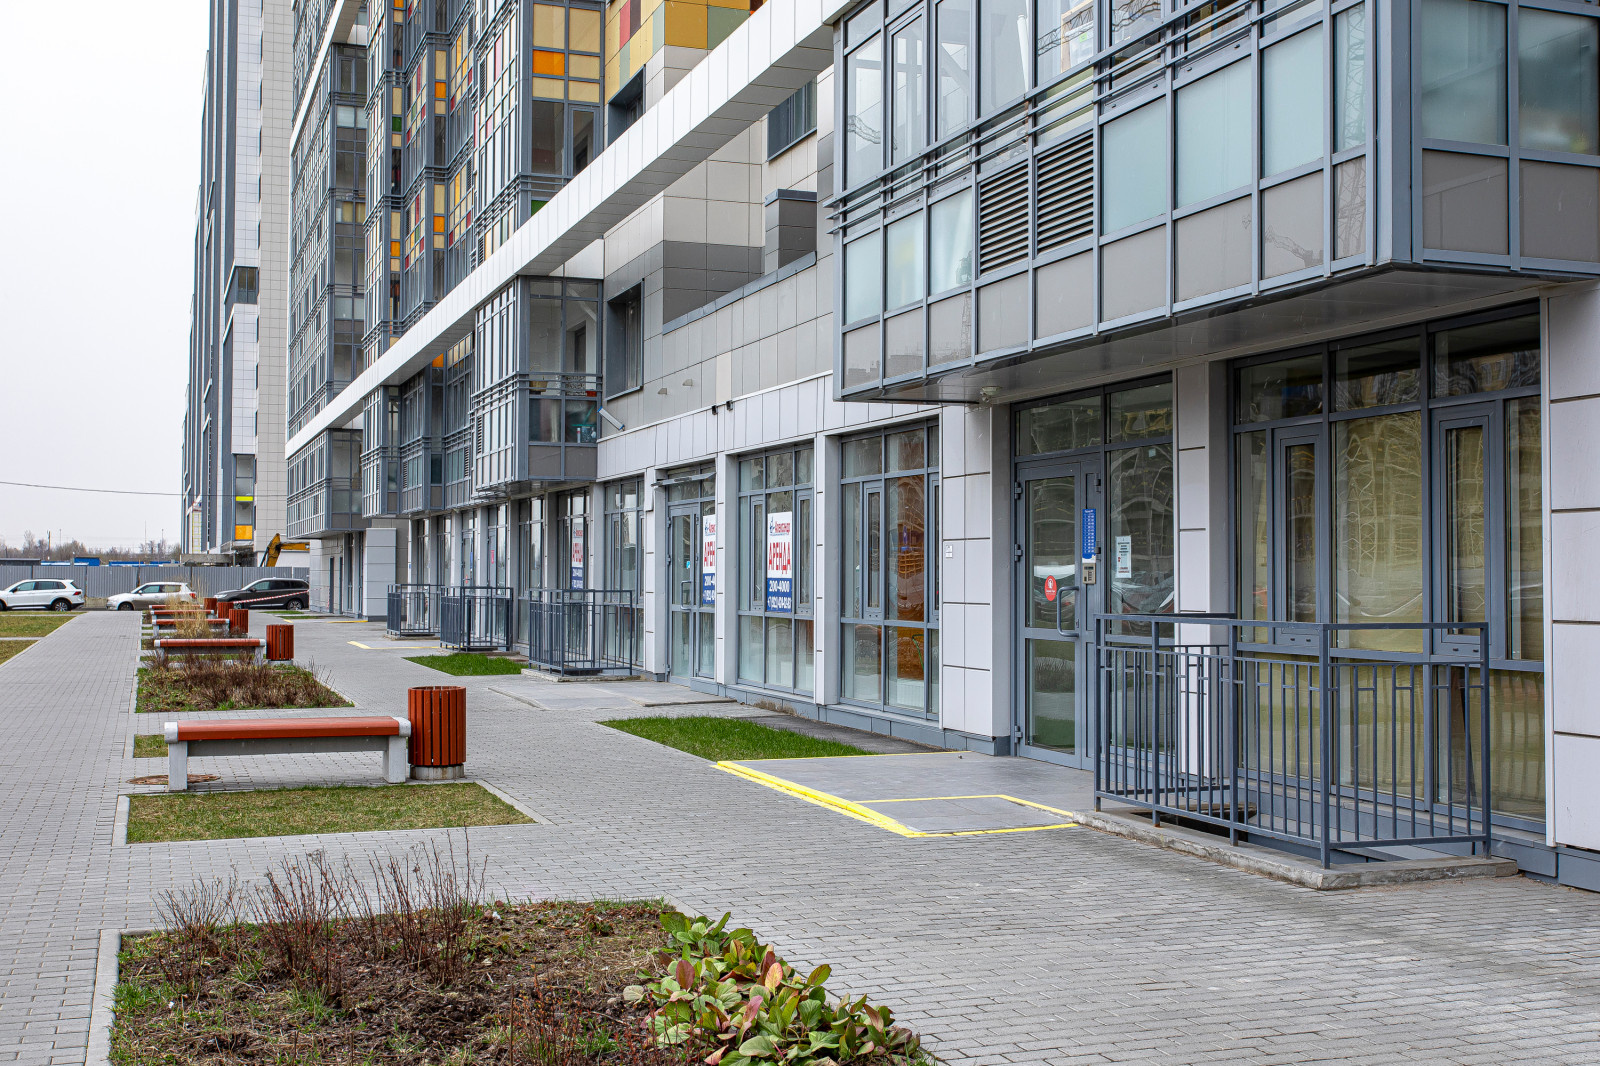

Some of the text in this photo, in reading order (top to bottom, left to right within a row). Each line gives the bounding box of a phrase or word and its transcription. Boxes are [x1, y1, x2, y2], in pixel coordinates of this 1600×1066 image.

[704, 541, 716, 567] АРЕН
[768, 541, 791, 574] АРЕНДА
[704, 575, 716, 587] 200-4
